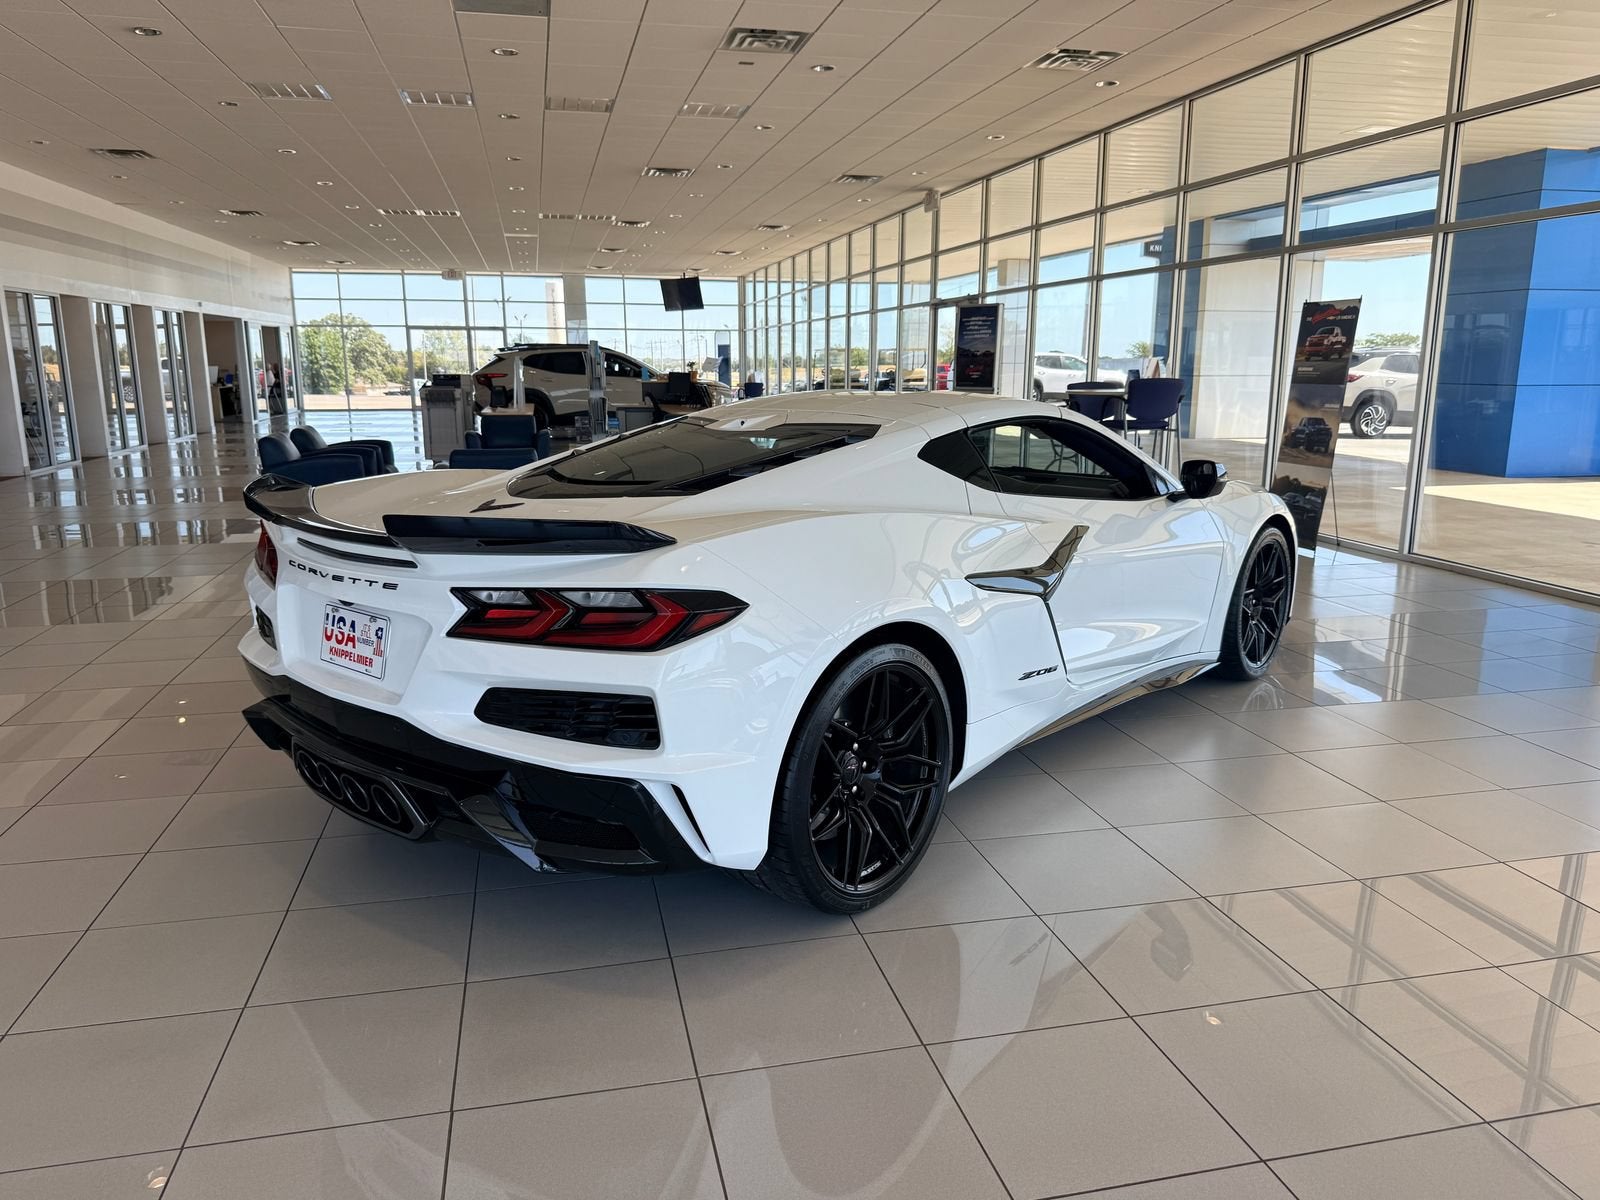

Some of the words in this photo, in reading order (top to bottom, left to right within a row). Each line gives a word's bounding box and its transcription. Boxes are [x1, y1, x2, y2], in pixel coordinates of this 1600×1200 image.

[288, 559, 399, 590] CORVETTE
[324, 613, 356, 649] USA
[329, 645, 374, 668] KNIPPELMIER
